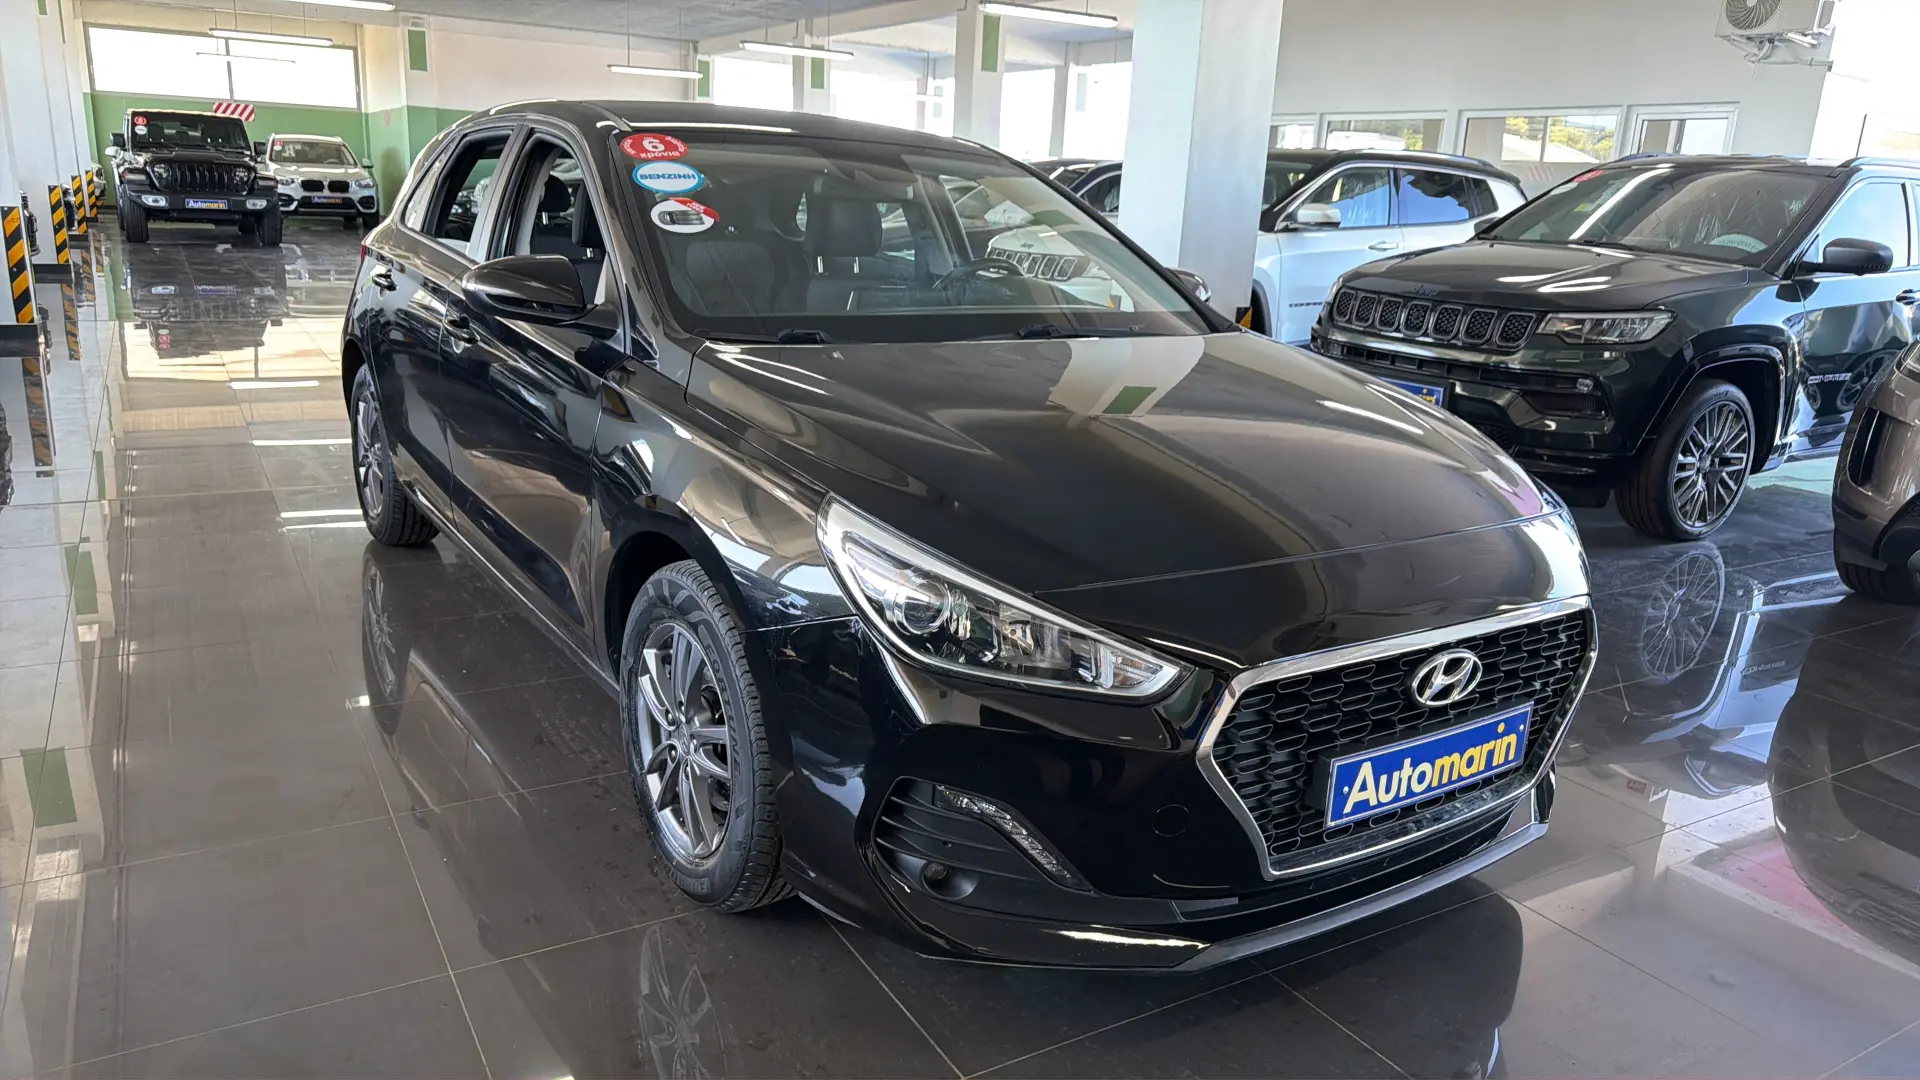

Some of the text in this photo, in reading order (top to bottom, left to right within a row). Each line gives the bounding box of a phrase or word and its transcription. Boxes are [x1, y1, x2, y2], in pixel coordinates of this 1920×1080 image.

[643, 138, 665, 152] 6
[188, 200, 225, 209] Automarin
[1343, 722, 1518, 815] Automarin
